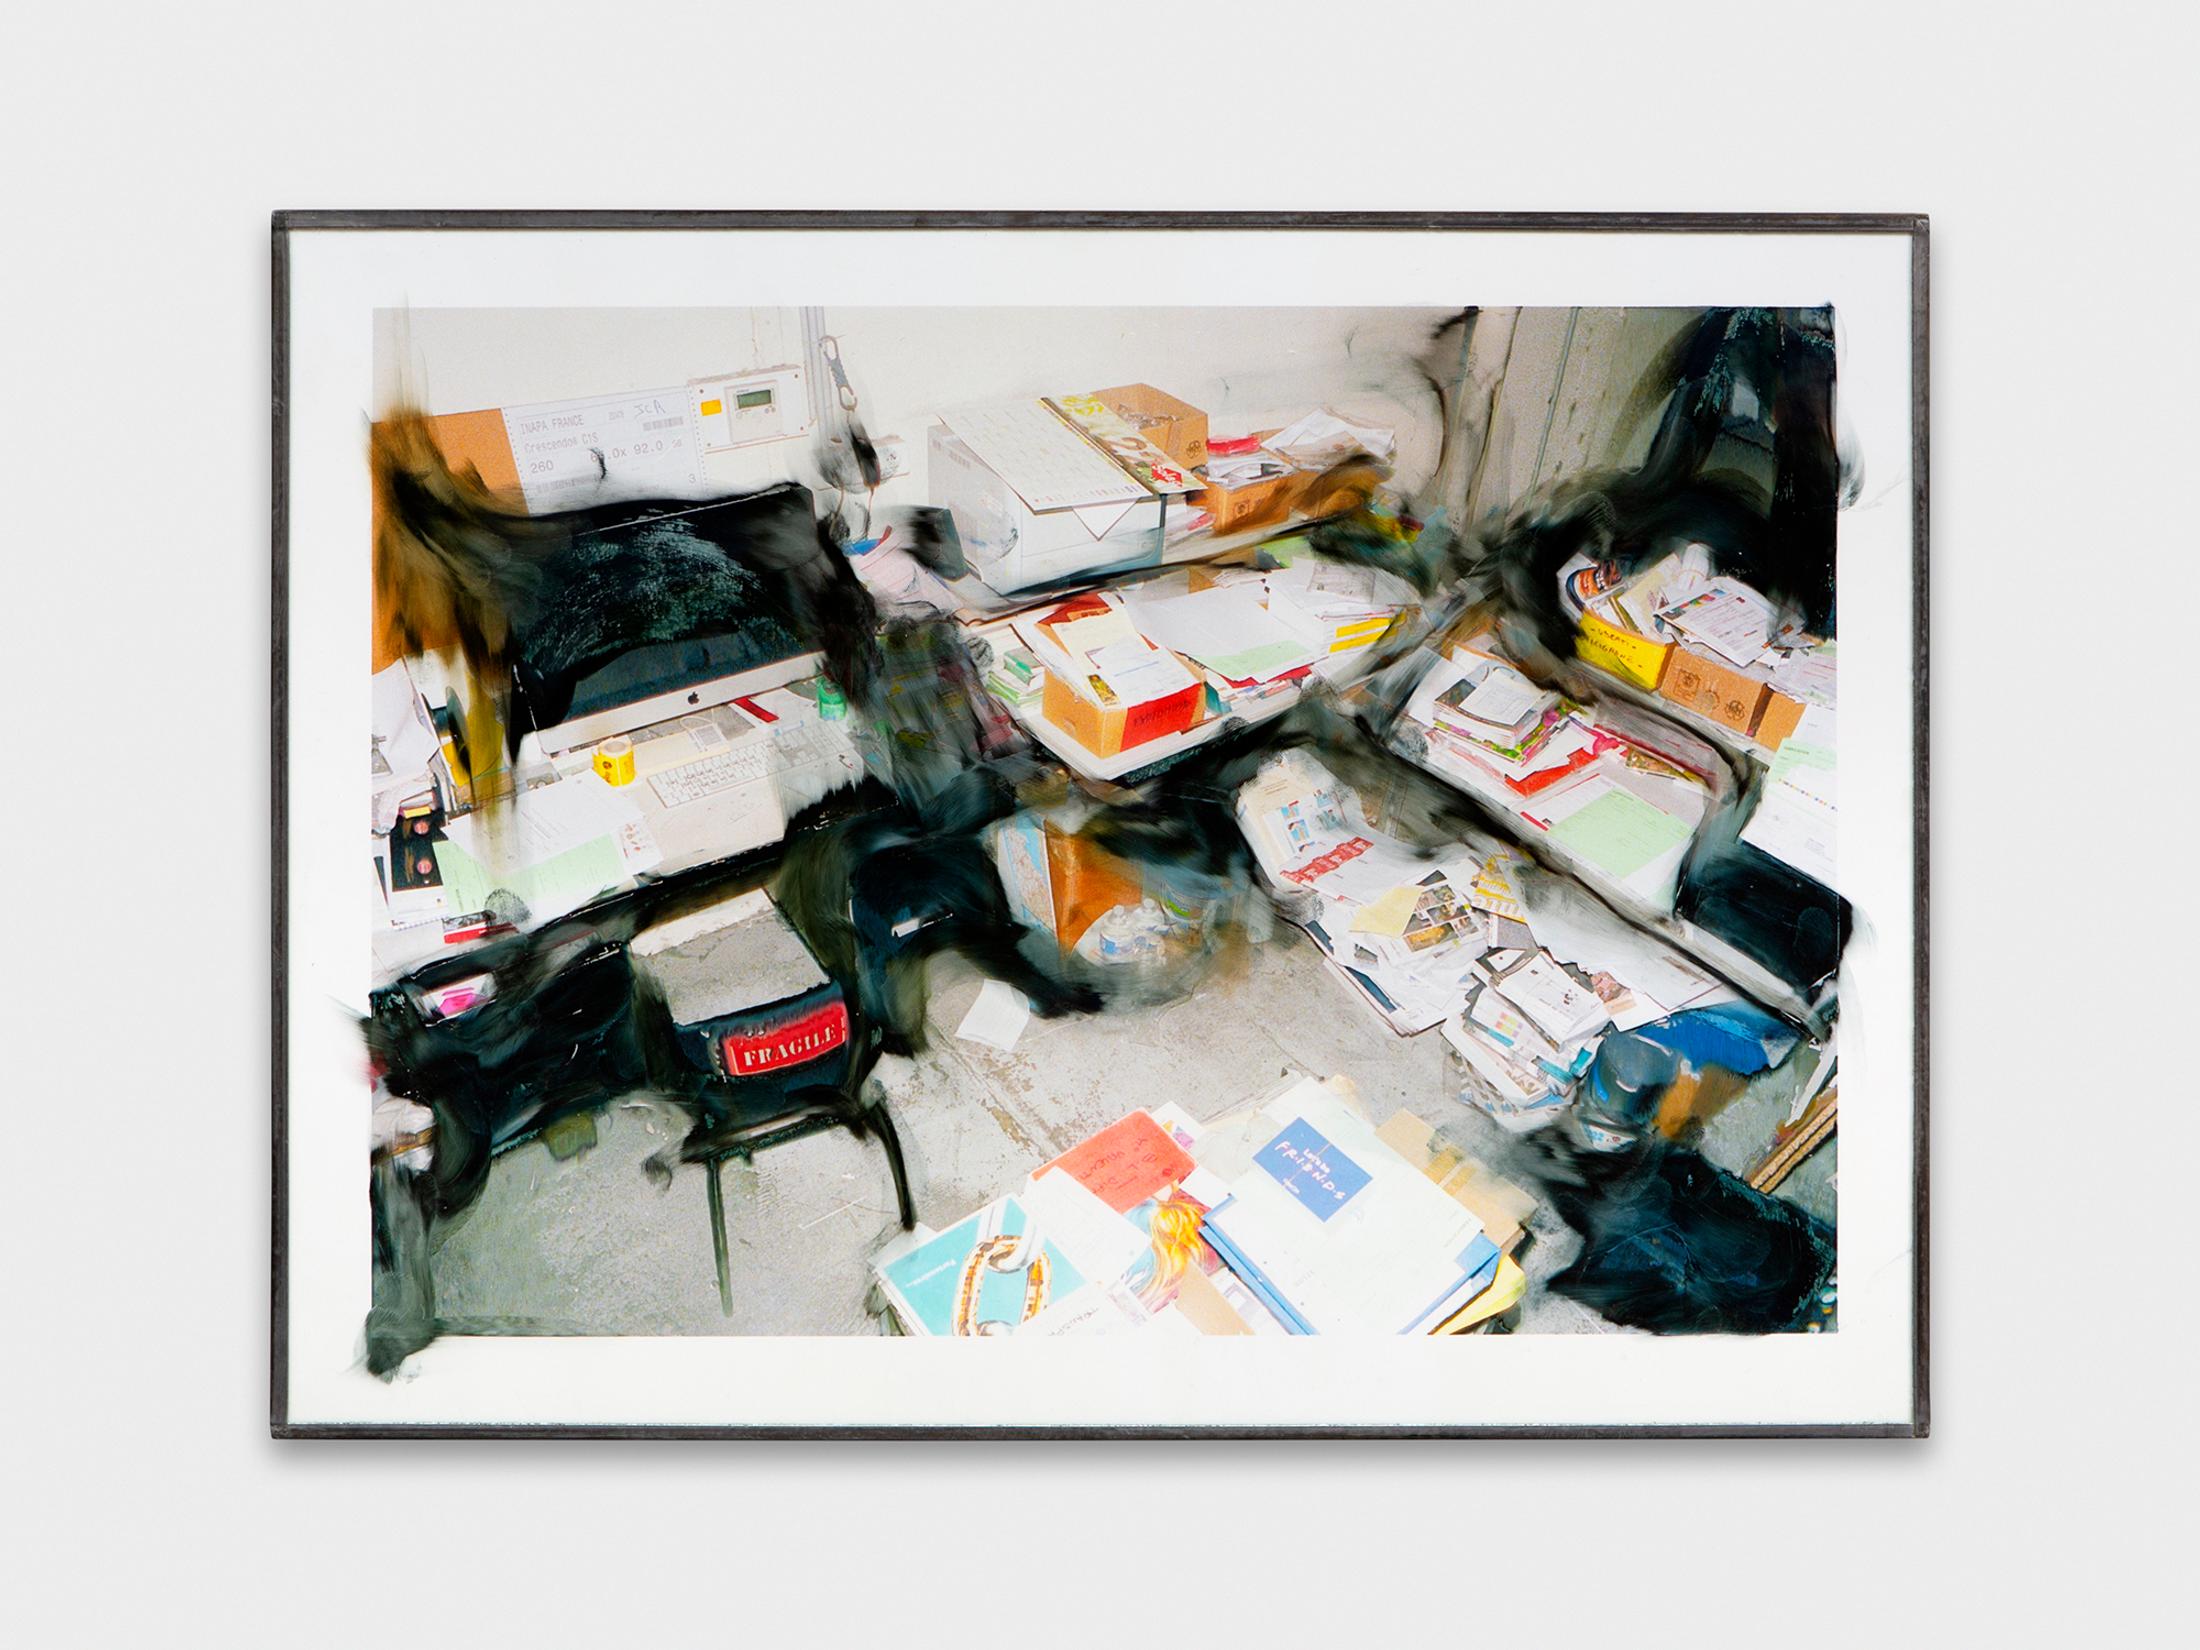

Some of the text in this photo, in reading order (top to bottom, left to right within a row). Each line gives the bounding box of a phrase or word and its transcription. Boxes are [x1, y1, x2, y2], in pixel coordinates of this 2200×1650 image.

[520, 414, 585, 435] INAPA FRANCE
[530, 460, 554, 474] 260
[590, 447, 627, 463] 6.0x
[633, 440, 664, 455] 92.0
[688, 473, 697, 484] 3
[743, 1023, 836, 1067] FRAGILE
